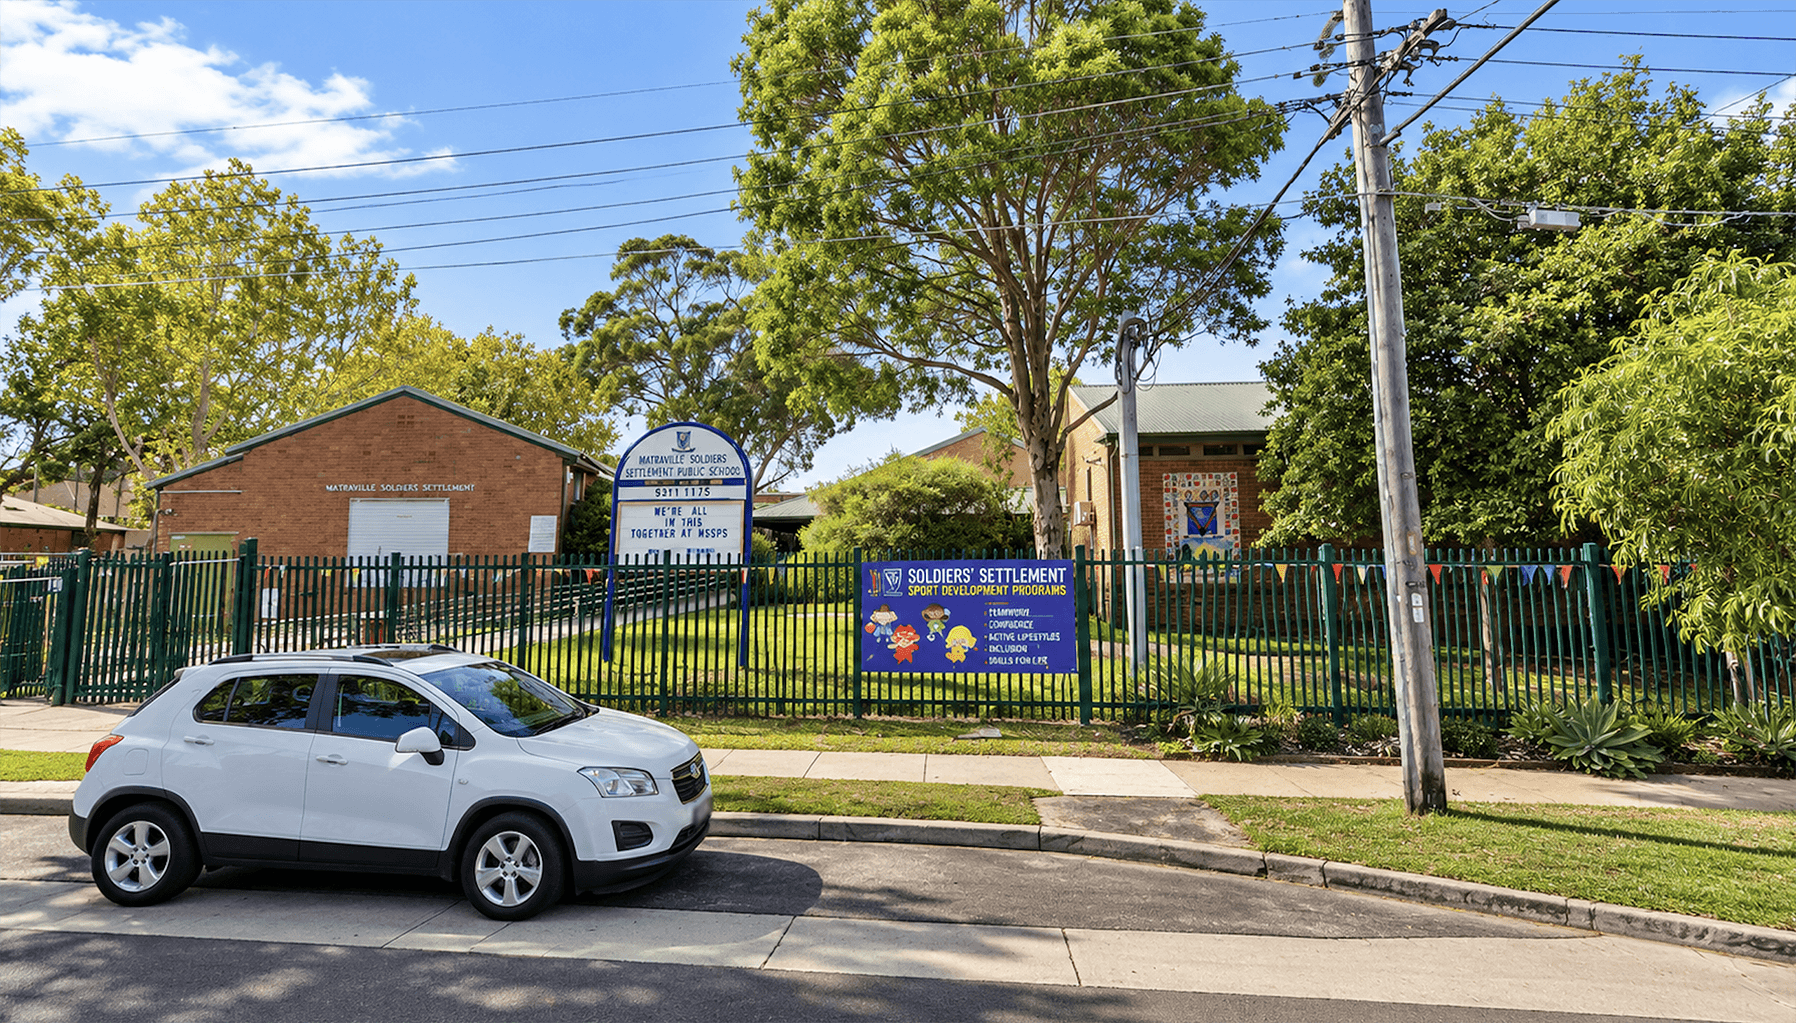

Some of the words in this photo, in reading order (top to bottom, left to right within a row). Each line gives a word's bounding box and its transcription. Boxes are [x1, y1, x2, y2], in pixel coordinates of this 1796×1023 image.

[639, 454, 685, 465] MATRAVILLE
[690, 453, 727, 464] SOLDIERS
[625, 466, 674, 478] SETTLEMENT
[677, 466, 705, 477] PUBLIC
[325, 483, 376, 492] MATRAVILLE
[380, 483, 419, 492] SOLDIERS
[422, 483, 475, 492] SETTLEMENT
[654, 506, 682, 516] WE'RE
[692, 506, 707, 516] ALL
[665, 518, 675, 527] IN
[682, 517, 703, 527] THIS
[631, 528, 676, 539] TOGETHER
[681, 528, 692, 538] AT
[908, 567, 974, 584] SOLDIERS'
[979, 567, 1067, 583] SETTLEMENT
[908, 585, 939, 596] SPORT
[941, 585, 1009, 596] DEVELOPMENT
[1012, 584, 1067, 596] PROGRAMS
